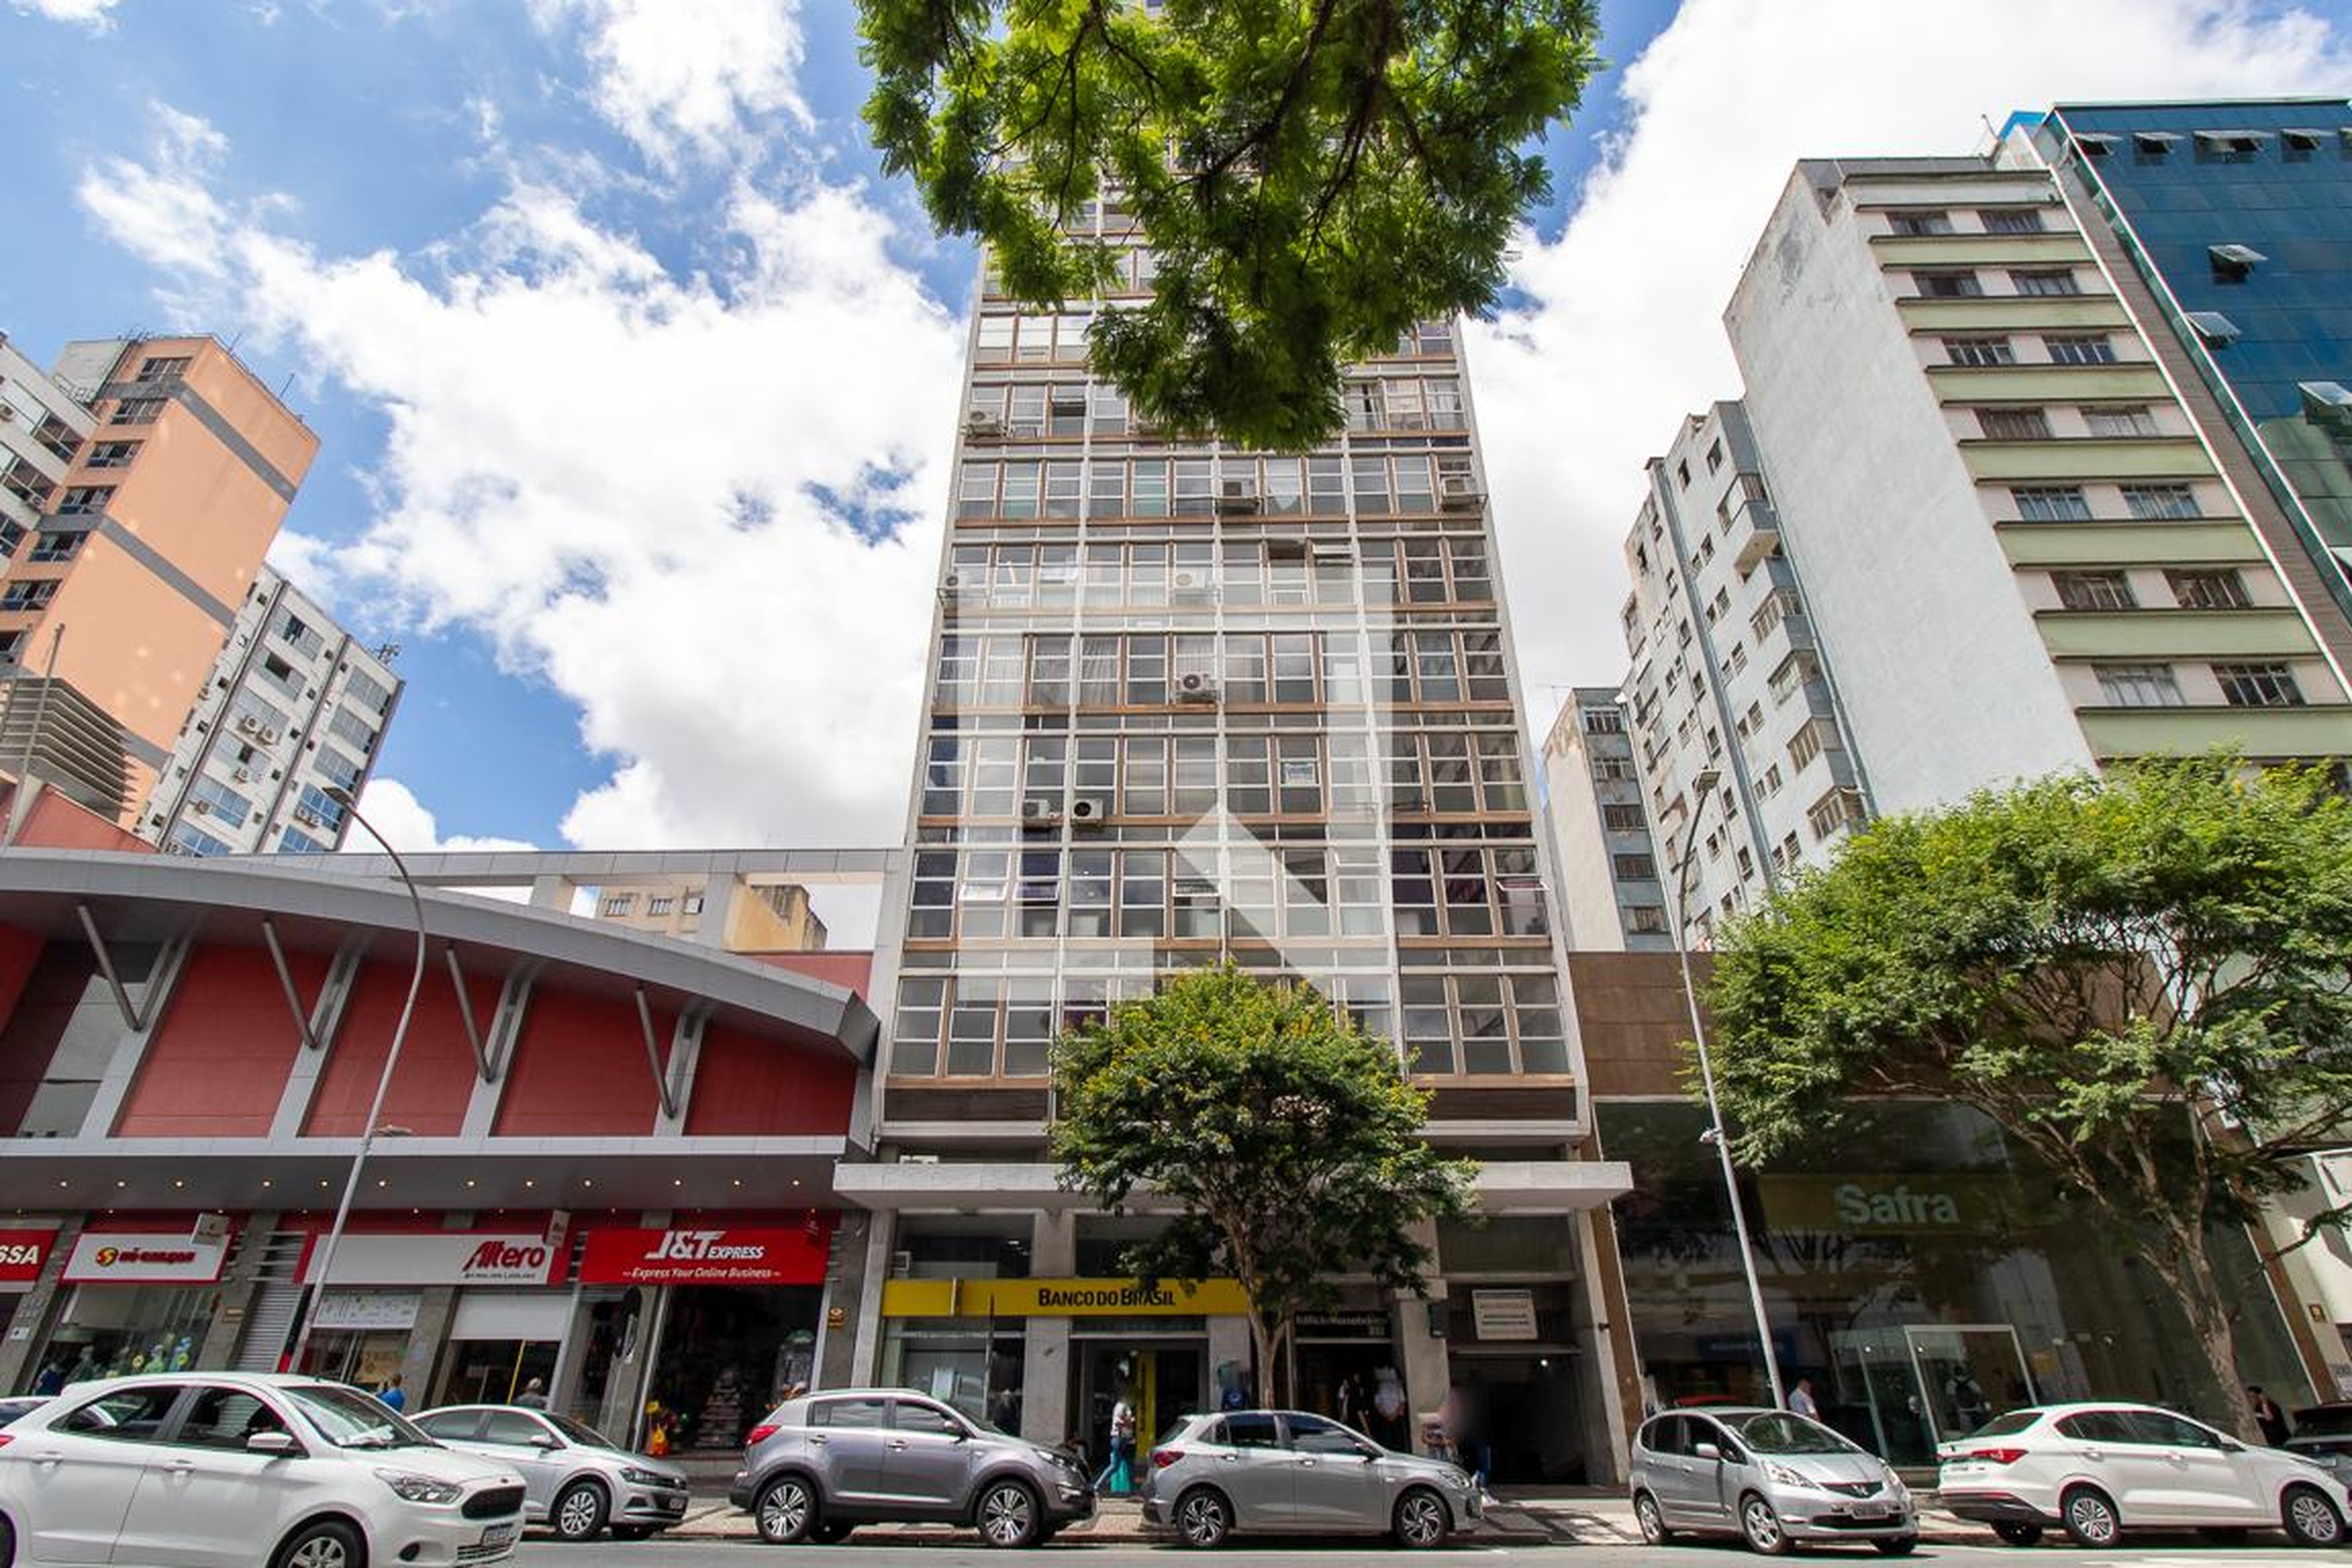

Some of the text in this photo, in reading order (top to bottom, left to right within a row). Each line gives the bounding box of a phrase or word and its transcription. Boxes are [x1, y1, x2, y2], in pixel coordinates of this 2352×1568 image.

[1834, 1184, 1960, 1224] Safra
[644, 1231, 764, 1260] J&T EXPRESS
[631, 1267, 772, 1280] Express Your Online Business
[1038, 1287, 1177, 1307] BANCO DO BRASIL
